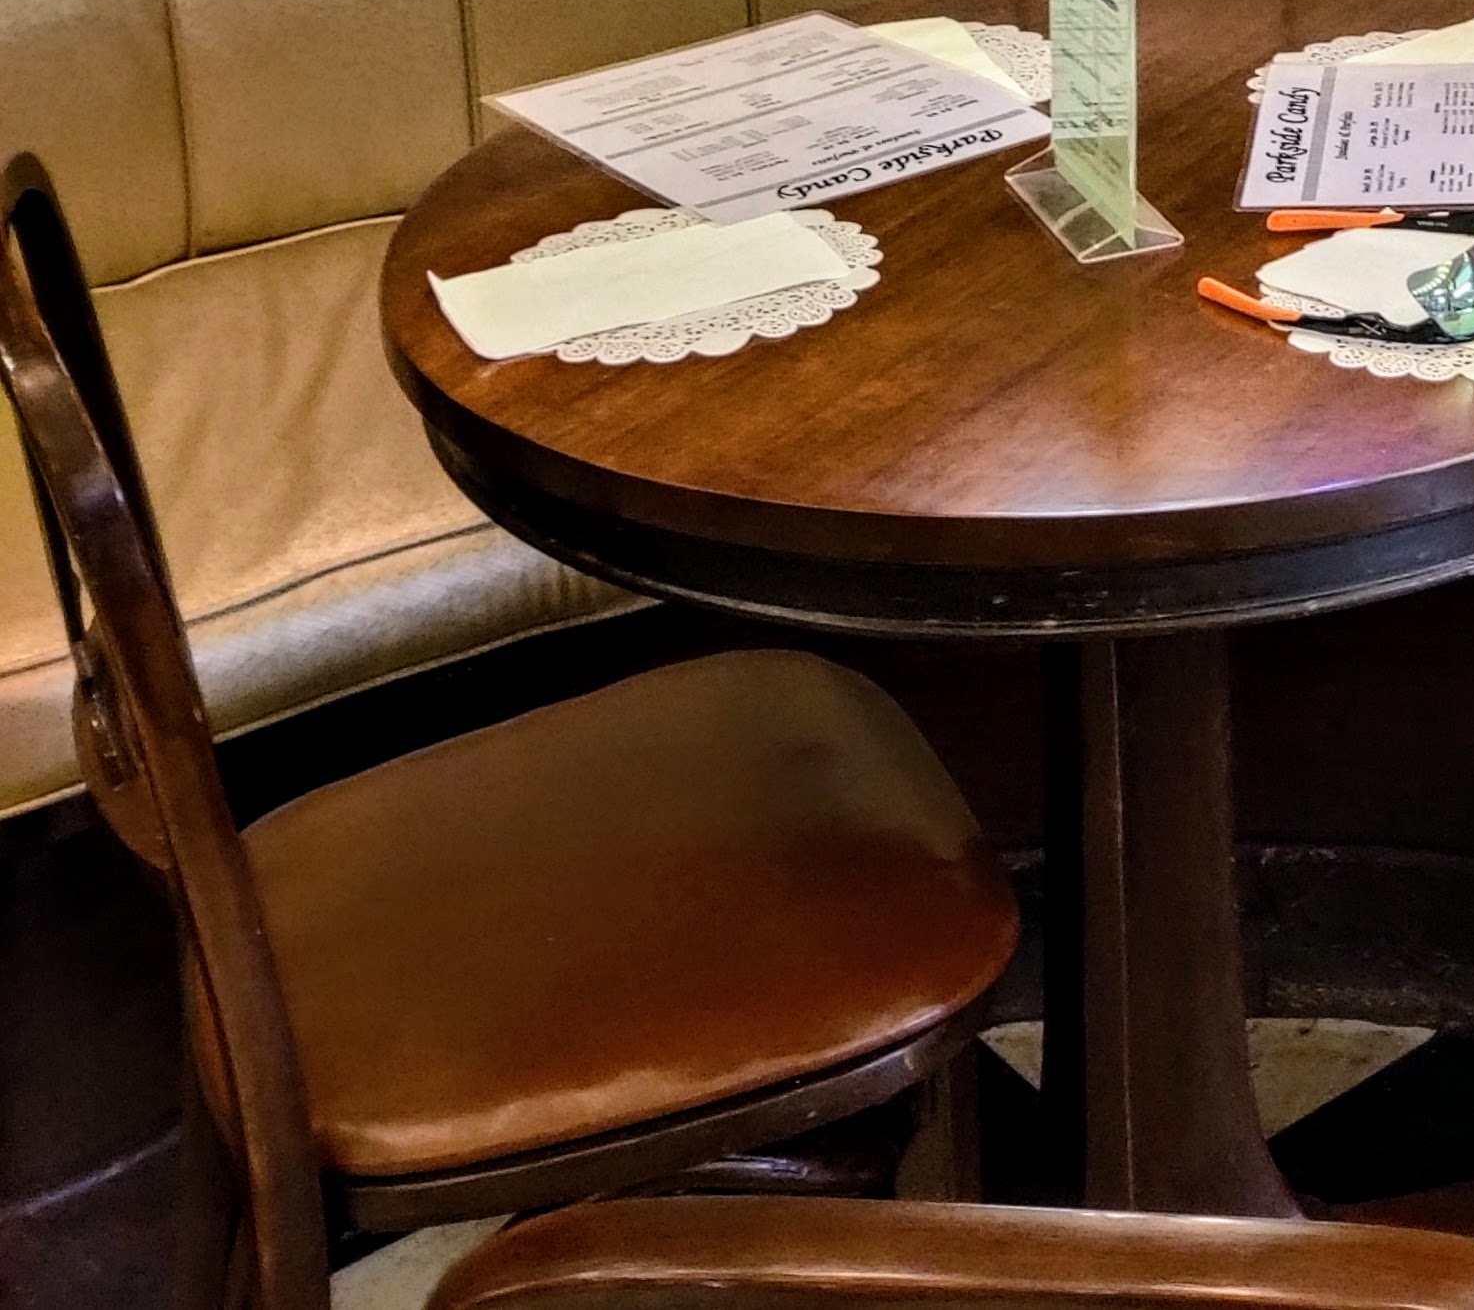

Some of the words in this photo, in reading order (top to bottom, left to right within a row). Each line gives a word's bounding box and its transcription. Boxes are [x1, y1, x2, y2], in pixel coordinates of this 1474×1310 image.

[1278, 87, 1321, 123] Candy
[878, 129, 1003, 172] Parkside
[1265, 126, 1308, 183] Parkside
[777, 167, 872, 199] Candy
